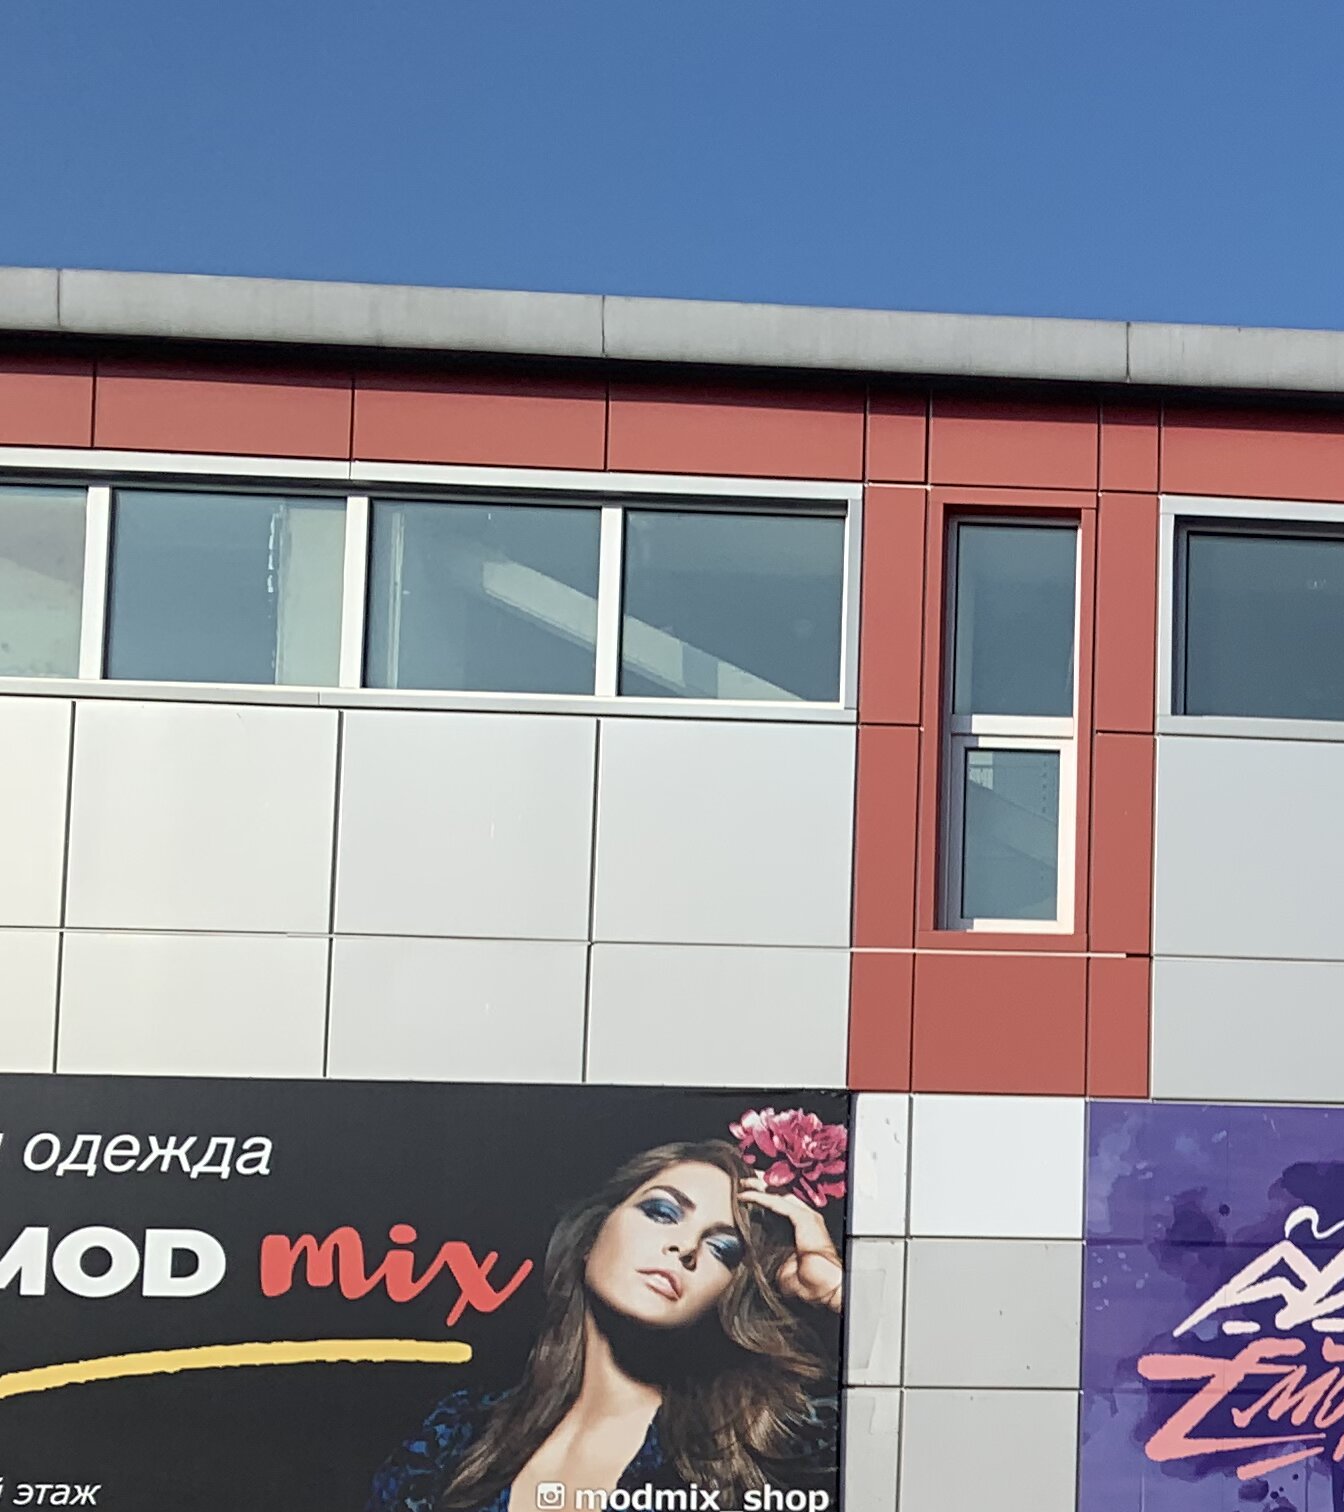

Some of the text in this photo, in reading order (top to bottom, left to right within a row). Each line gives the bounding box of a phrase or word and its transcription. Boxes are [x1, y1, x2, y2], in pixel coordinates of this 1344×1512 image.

[23, 1132, 273, 1179] одежда
[260, 1223, 534, 1327] mix
[12, 1483, 102, 1505] этаж
